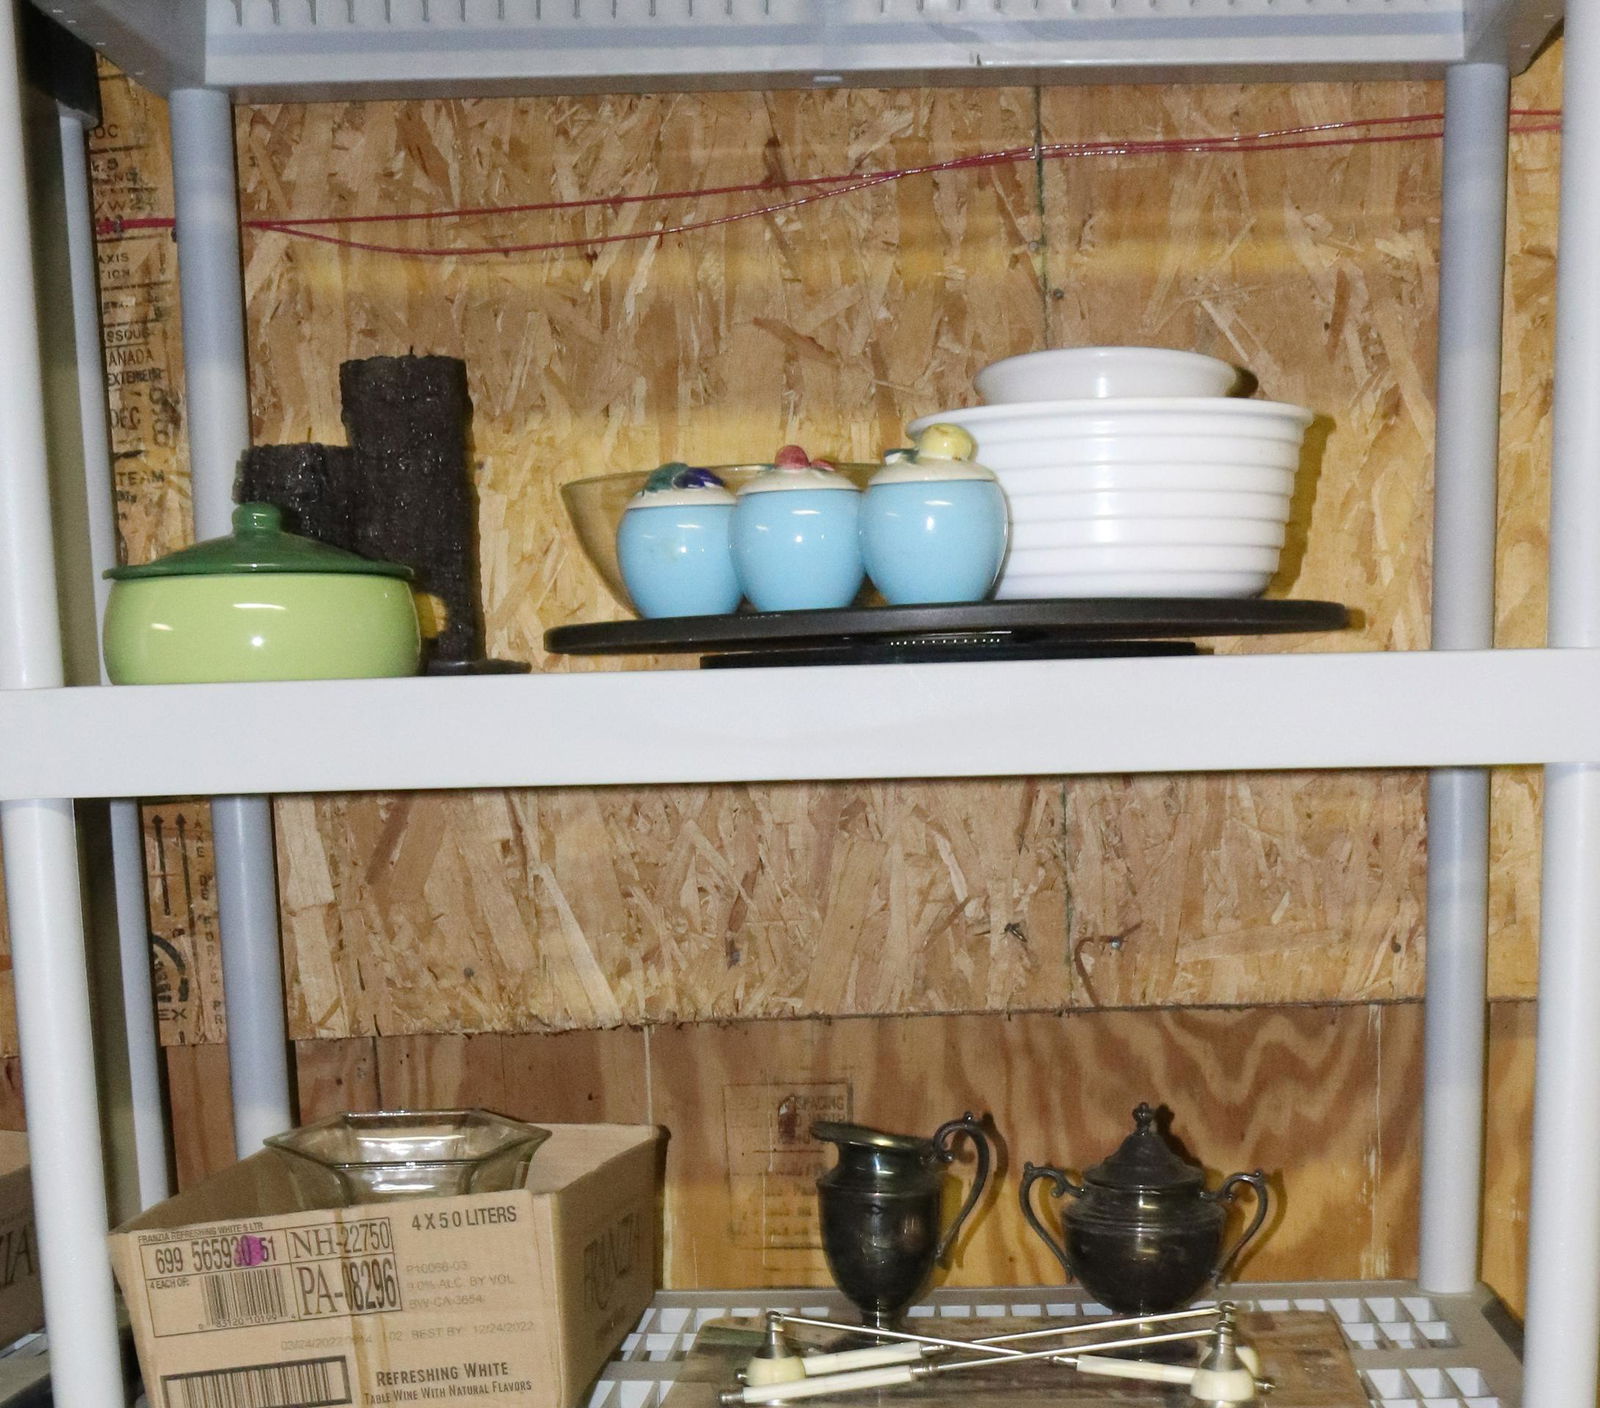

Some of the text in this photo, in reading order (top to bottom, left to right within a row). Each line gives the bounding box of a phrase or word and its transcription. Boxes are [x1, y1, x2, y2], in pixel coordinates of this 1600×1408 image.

[411, 1214, 421, 1231] 4
[424, 1212, 436, 1230] X
[465, 1205, 517, 1227] LITERS
[289, 1220, 390, 1259] NH-22750
[155, 1246, 184, 1275] 699
[156, 1279, 176, 1290] EACH
[296, 1257, 397, 1316] PA-08296
[375, 1361, 510, 1388] REFRESHING WHITE
[363, 1380, 532, 1406] TABLE WINE WITH NATURAL FLAVORS
